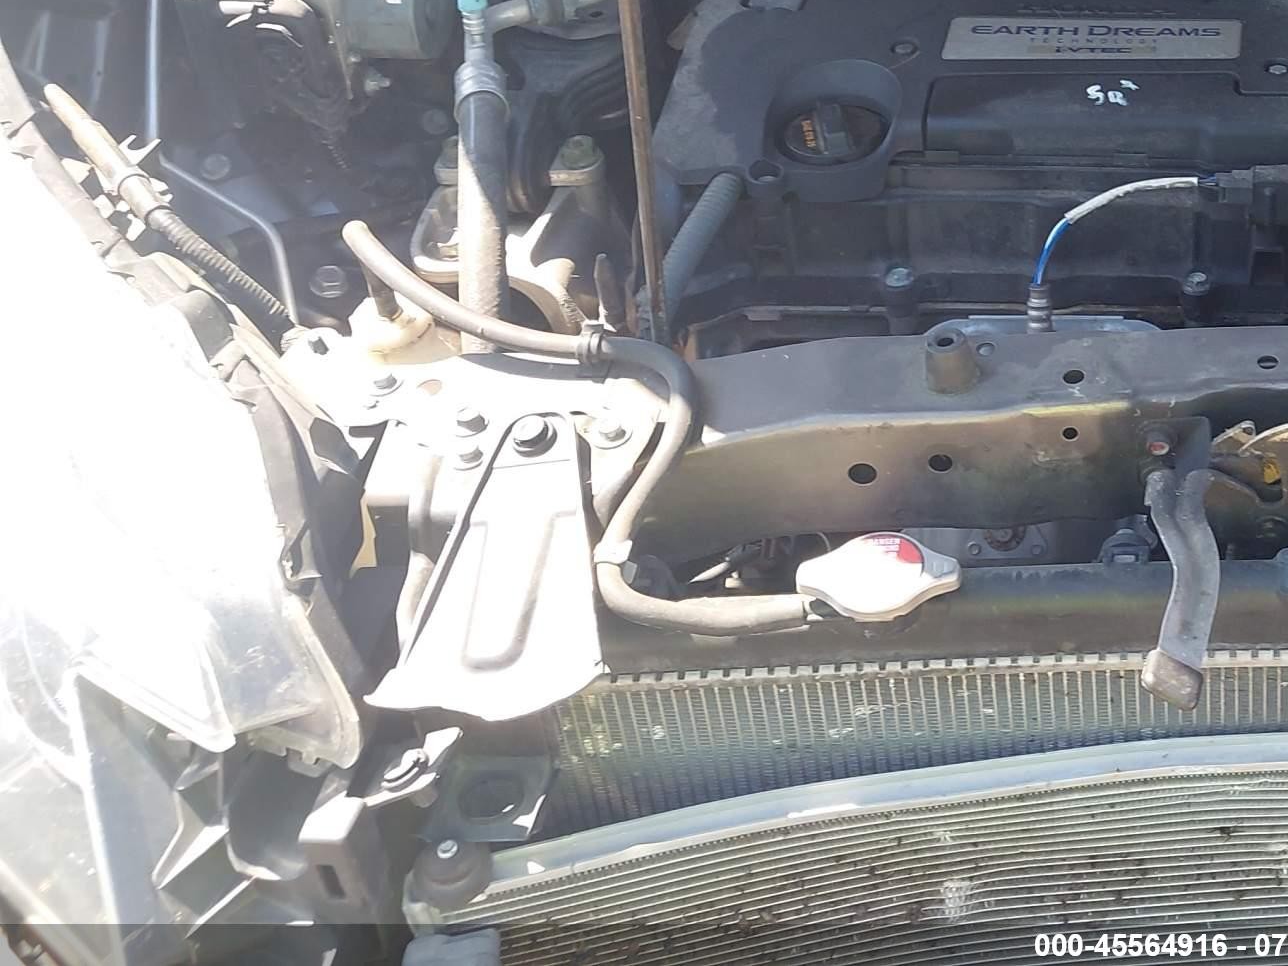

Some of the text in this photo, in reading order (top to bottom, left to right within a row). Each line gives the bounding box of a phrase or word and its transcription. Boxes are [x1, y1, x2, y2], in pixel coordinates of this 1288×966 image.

[971, 25, 1221, 37] EARTH DREAMS
[1029, 37, 1158, 45] TECHNOLOGY
